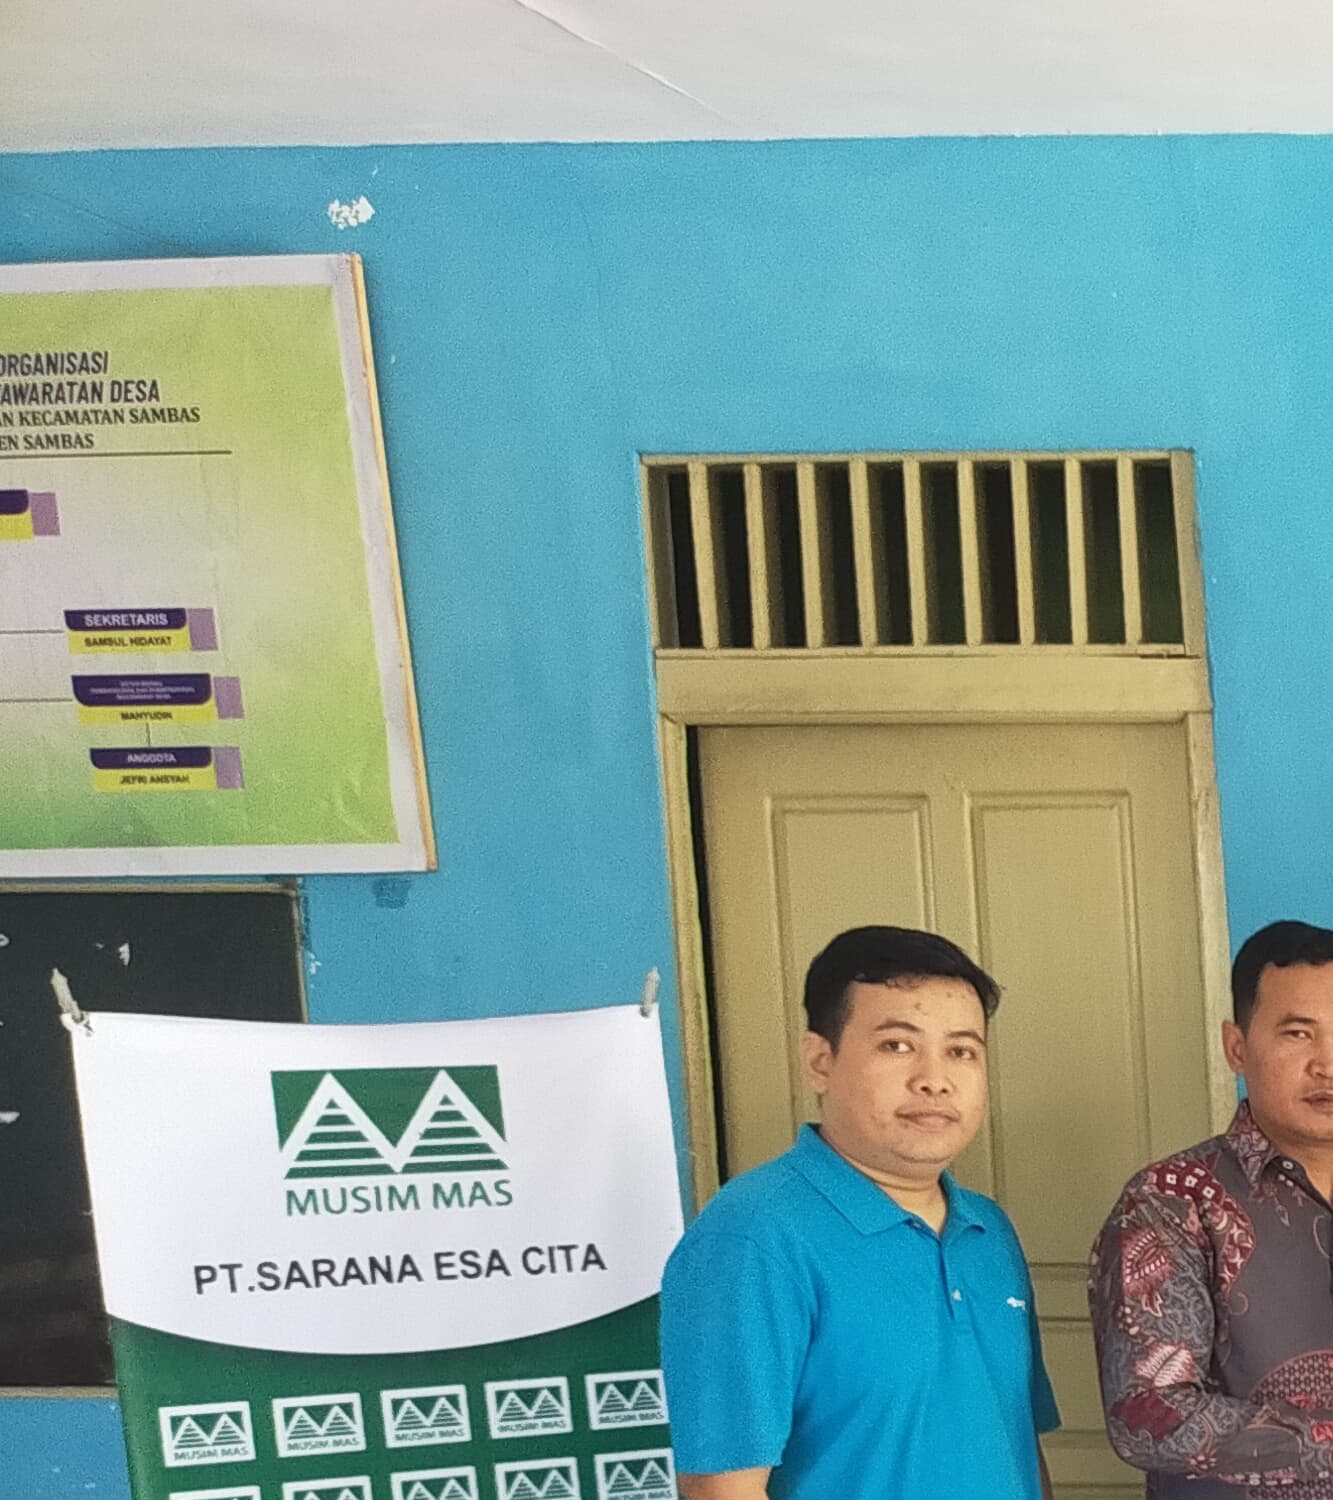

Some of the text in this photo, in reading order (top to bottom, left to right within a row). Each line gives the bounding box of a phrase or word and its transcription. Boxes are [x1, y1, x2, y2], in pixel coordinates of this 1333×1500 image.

[0, 379, 160, 407] AWARATAN DESA
[20, 408, 124, 426] KECAMATAN
[130, 406, 200, 424] SAMBAS
[23, 433, 94, 450] SAMBAS
[85, 613, 168, 627] SEKRETARIS
[285, 1178, 514, 1217] MUSIM MAS
[193, 1243, 608, 1296] PT.SARANA ESA CITA
[173, 1444, 251, 1461] MUSIM MAS
